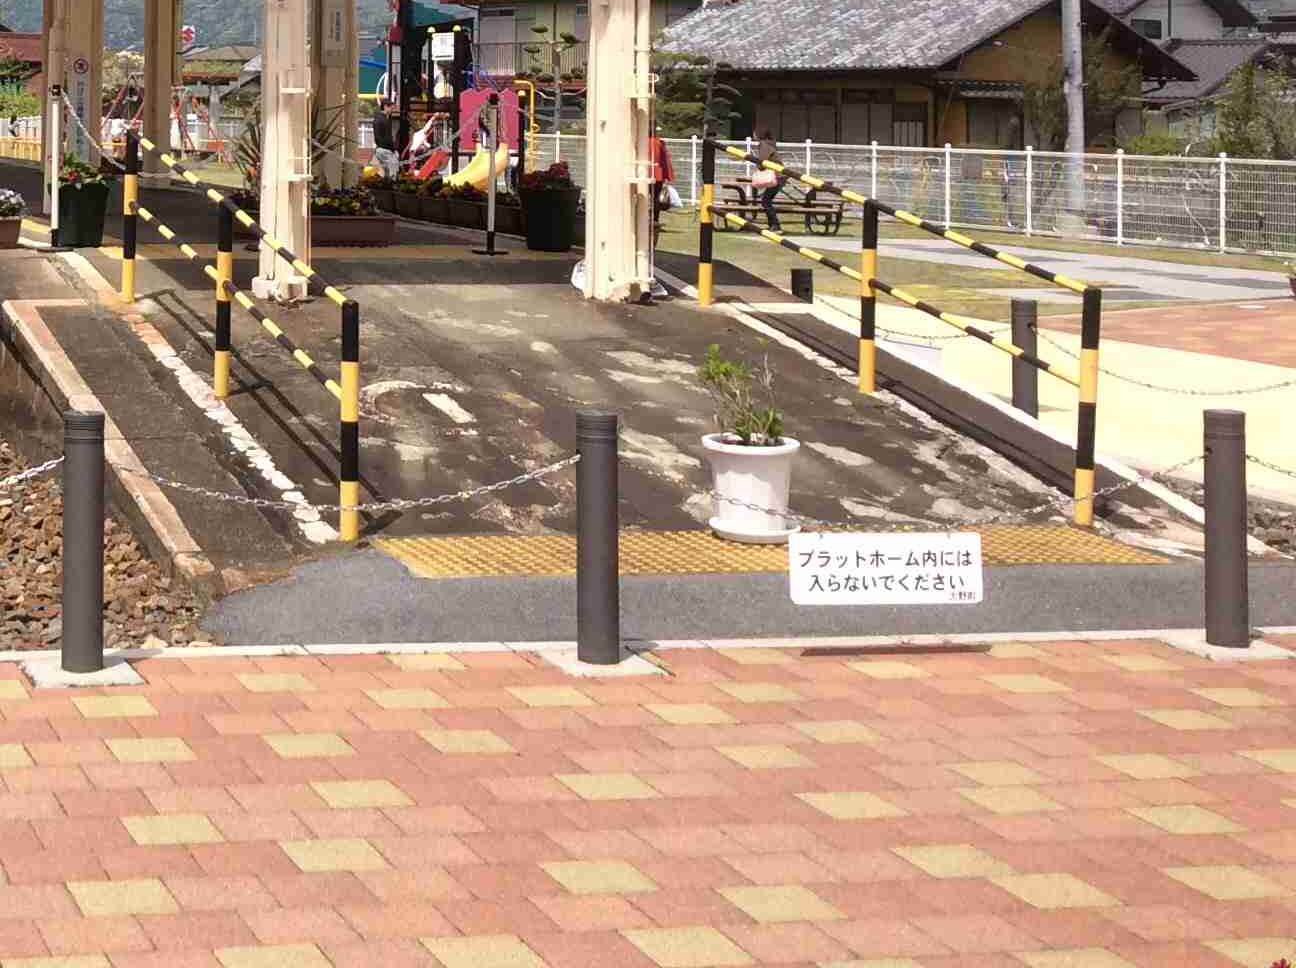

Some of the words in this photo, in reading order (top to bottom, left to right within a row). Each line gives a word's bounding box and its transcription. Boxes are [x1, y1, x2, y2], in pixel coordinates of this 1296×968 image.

[798, 549, 973, 568] プラットホーム内には
[808, 574, 965, 592] 入らないでください
